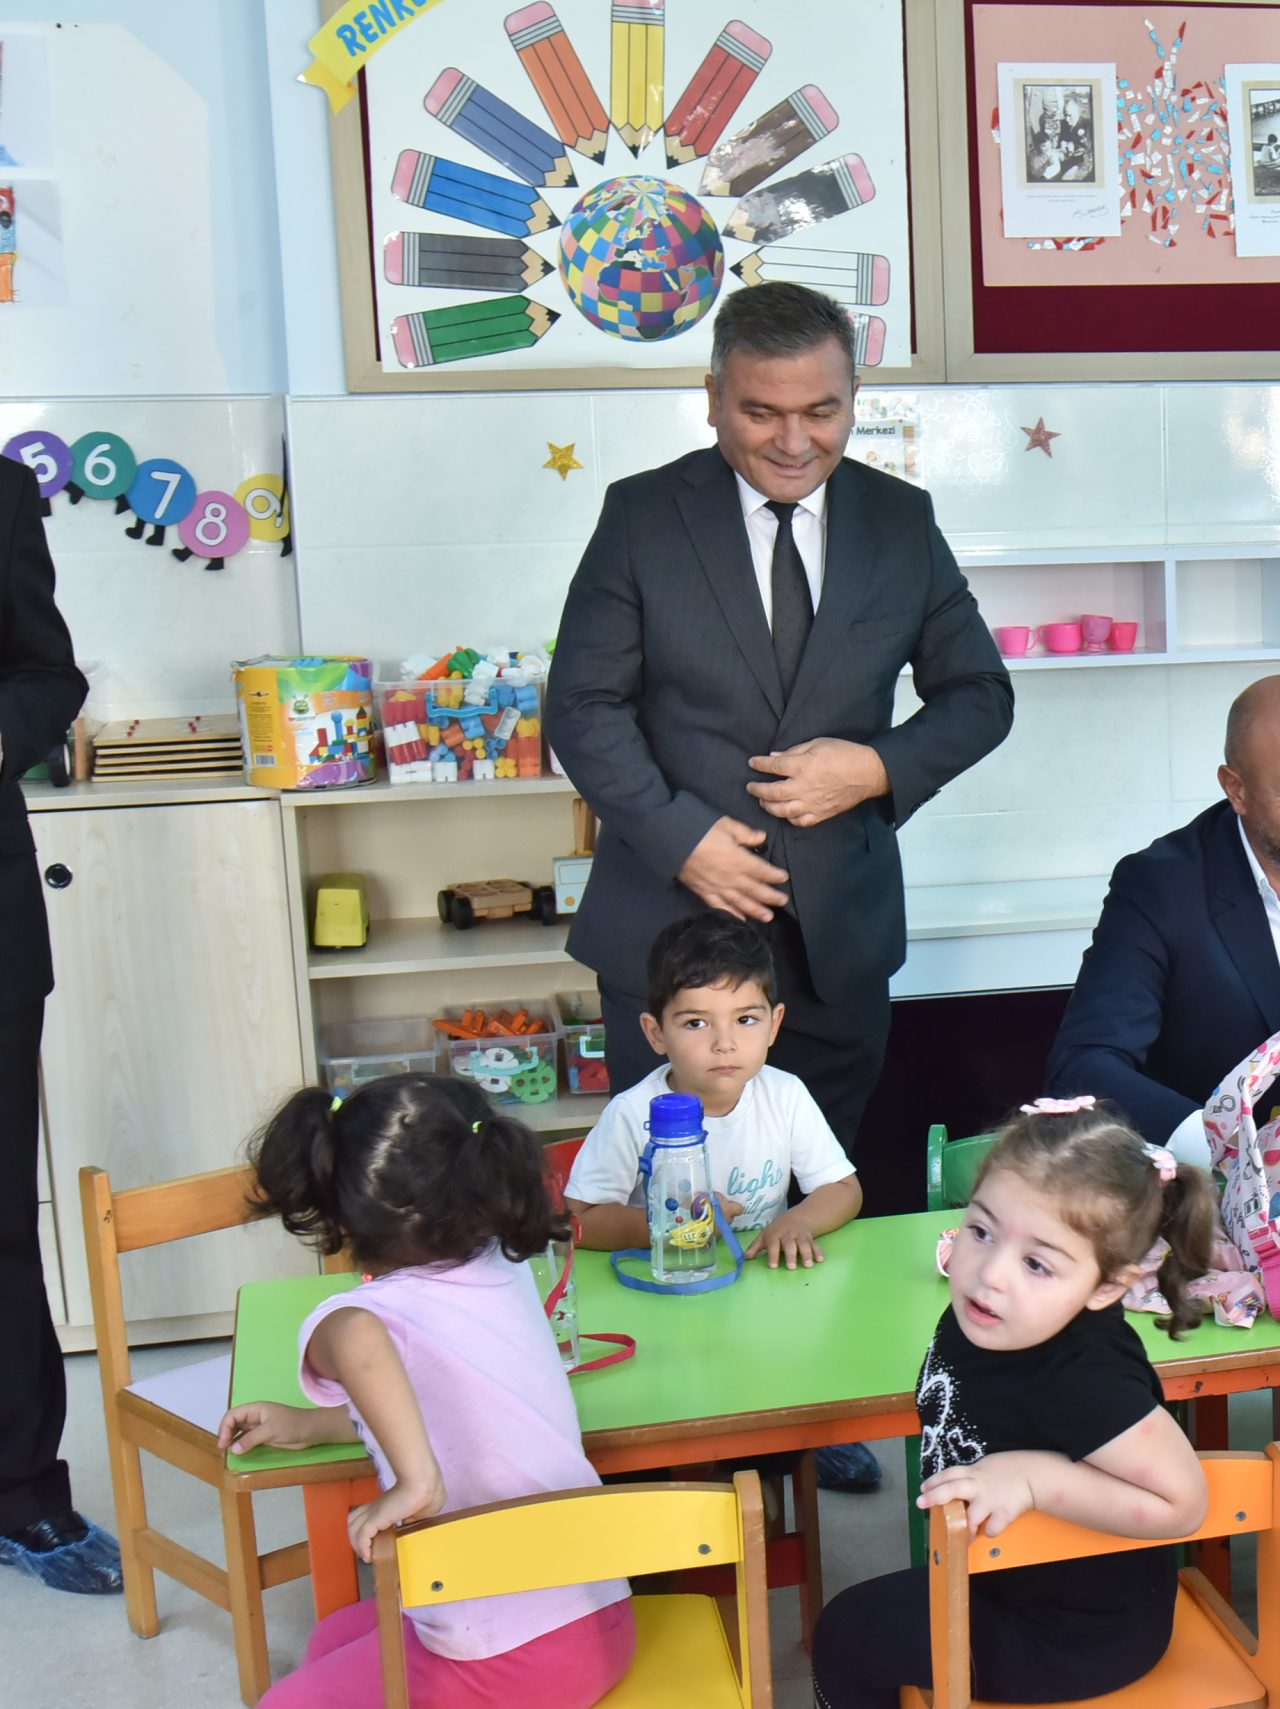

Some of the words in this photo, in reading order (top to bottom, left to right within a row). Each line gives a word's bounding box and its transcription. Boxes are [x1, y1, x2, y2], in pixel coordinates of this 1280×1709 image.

[336, 0, 427, 57] RENK
[856, 426, 896, 436] Merkezi
[19, 441, 58, 484] 5
[84, 443, 117, 486] 6
[150, 471, 182, 520] 7
[195, 502, 228, 546] 8
